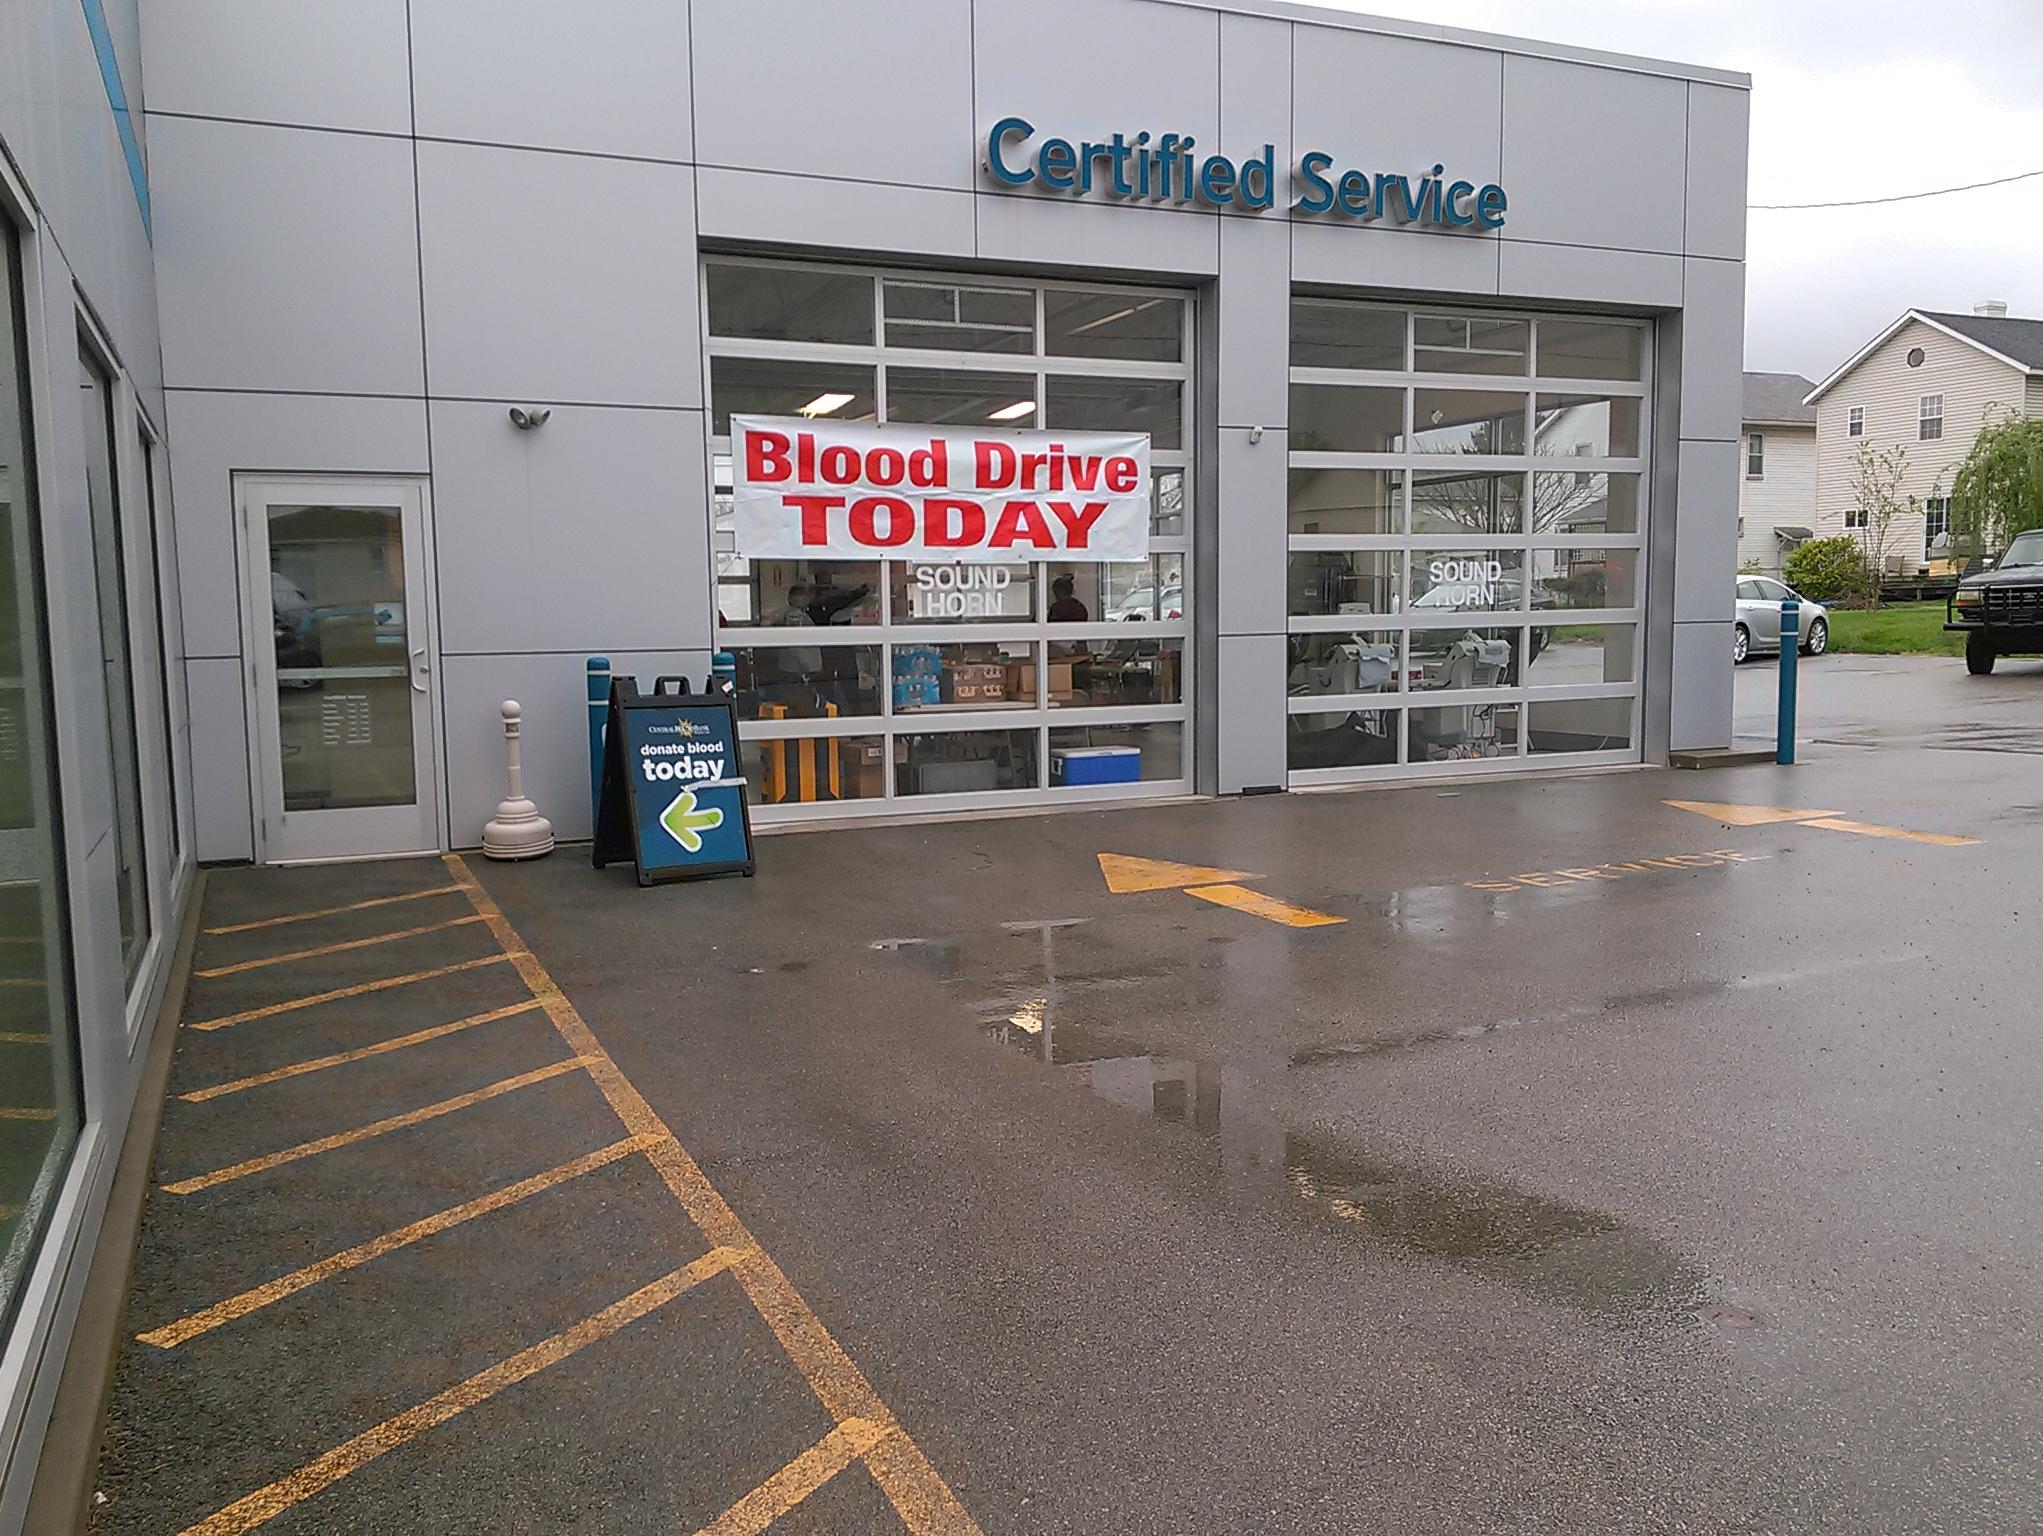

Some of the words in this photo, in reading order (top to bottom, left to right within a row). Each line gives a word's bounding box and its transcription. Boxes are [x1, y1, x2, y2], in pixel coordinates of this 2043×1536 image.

[986, 116, 1276, 212] Certified
[1297, 150, 1509, 231] Service
[745, 430, 949, 488] Blood
[974, 440, 1139, 493] Drive
[781, 494, 1110, 549] TODAY
[916, 566, 1011, 590] SOUND
[1429, 561, 1502, 582] SOUND
[927, 592, 1002, 616] HORN
[640, 743, 685, 756] donate
[687, 740, 724, 754] blood
[642, 755, 725, 782] today
